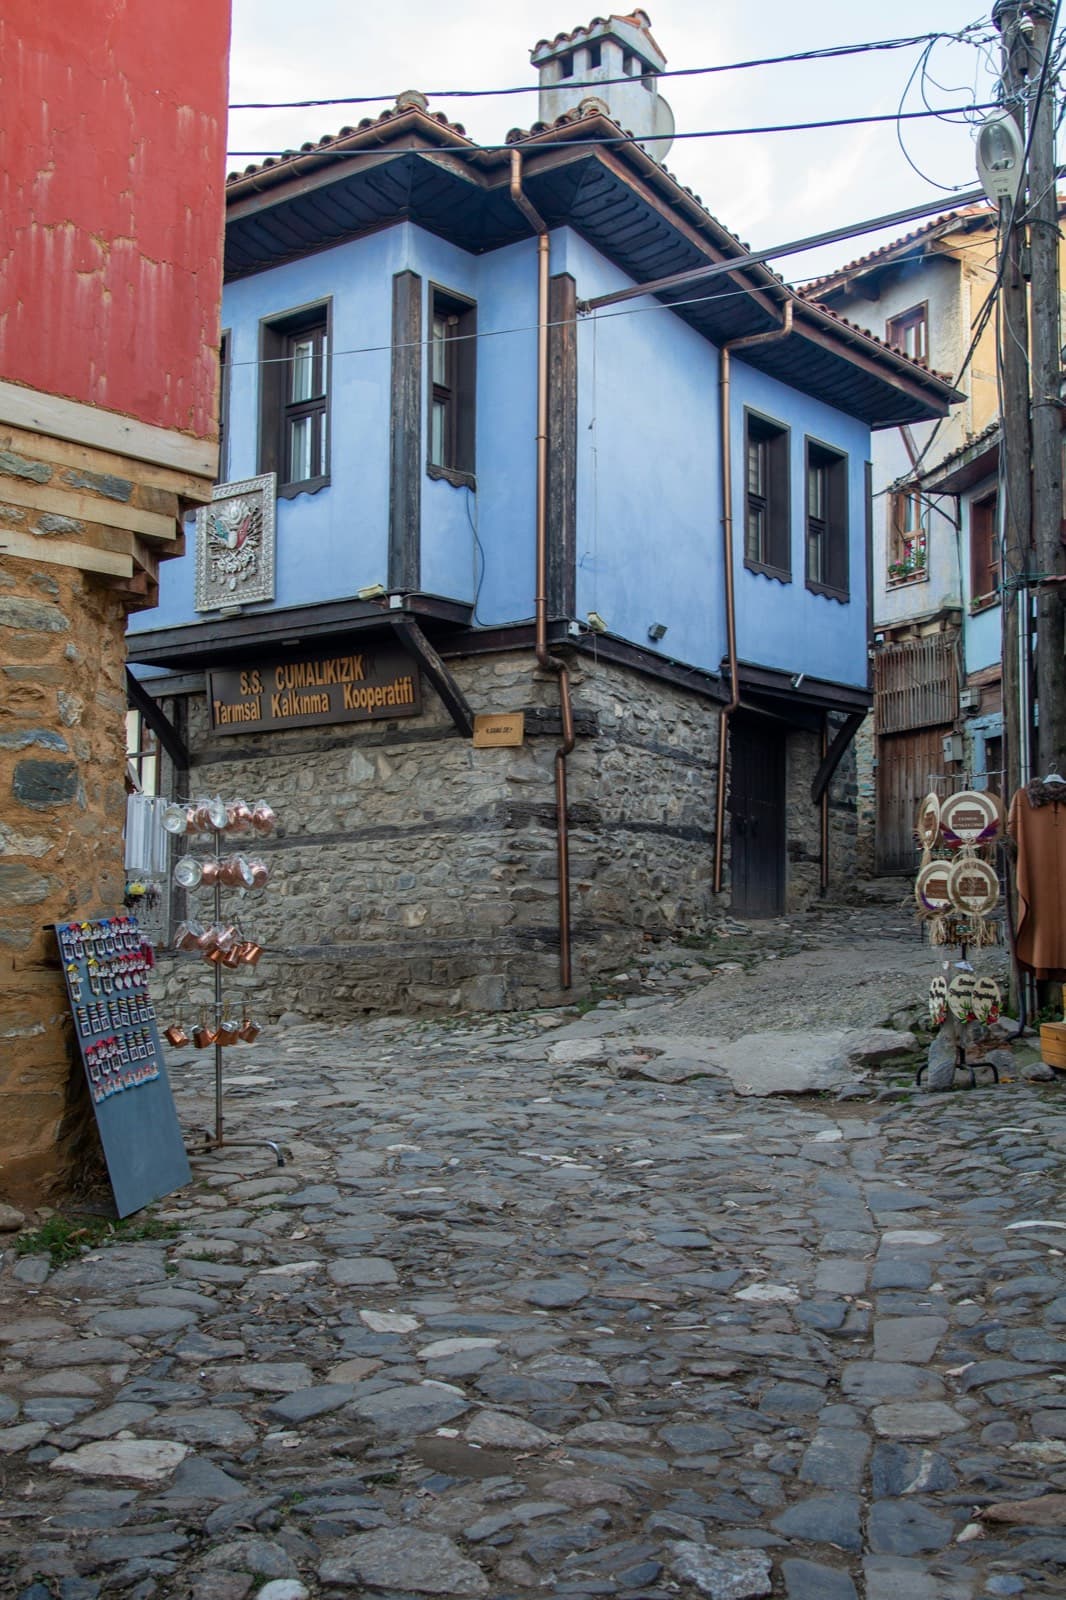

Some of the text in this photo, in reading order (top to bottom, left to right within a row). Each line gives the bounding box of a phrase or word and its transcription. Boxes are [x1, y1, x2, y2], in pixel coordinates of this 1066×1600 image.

[213, 676, 413, 724] Tarımsal Kalkınma Kooperatifi
[240, 670, 263, 695] S.S.
